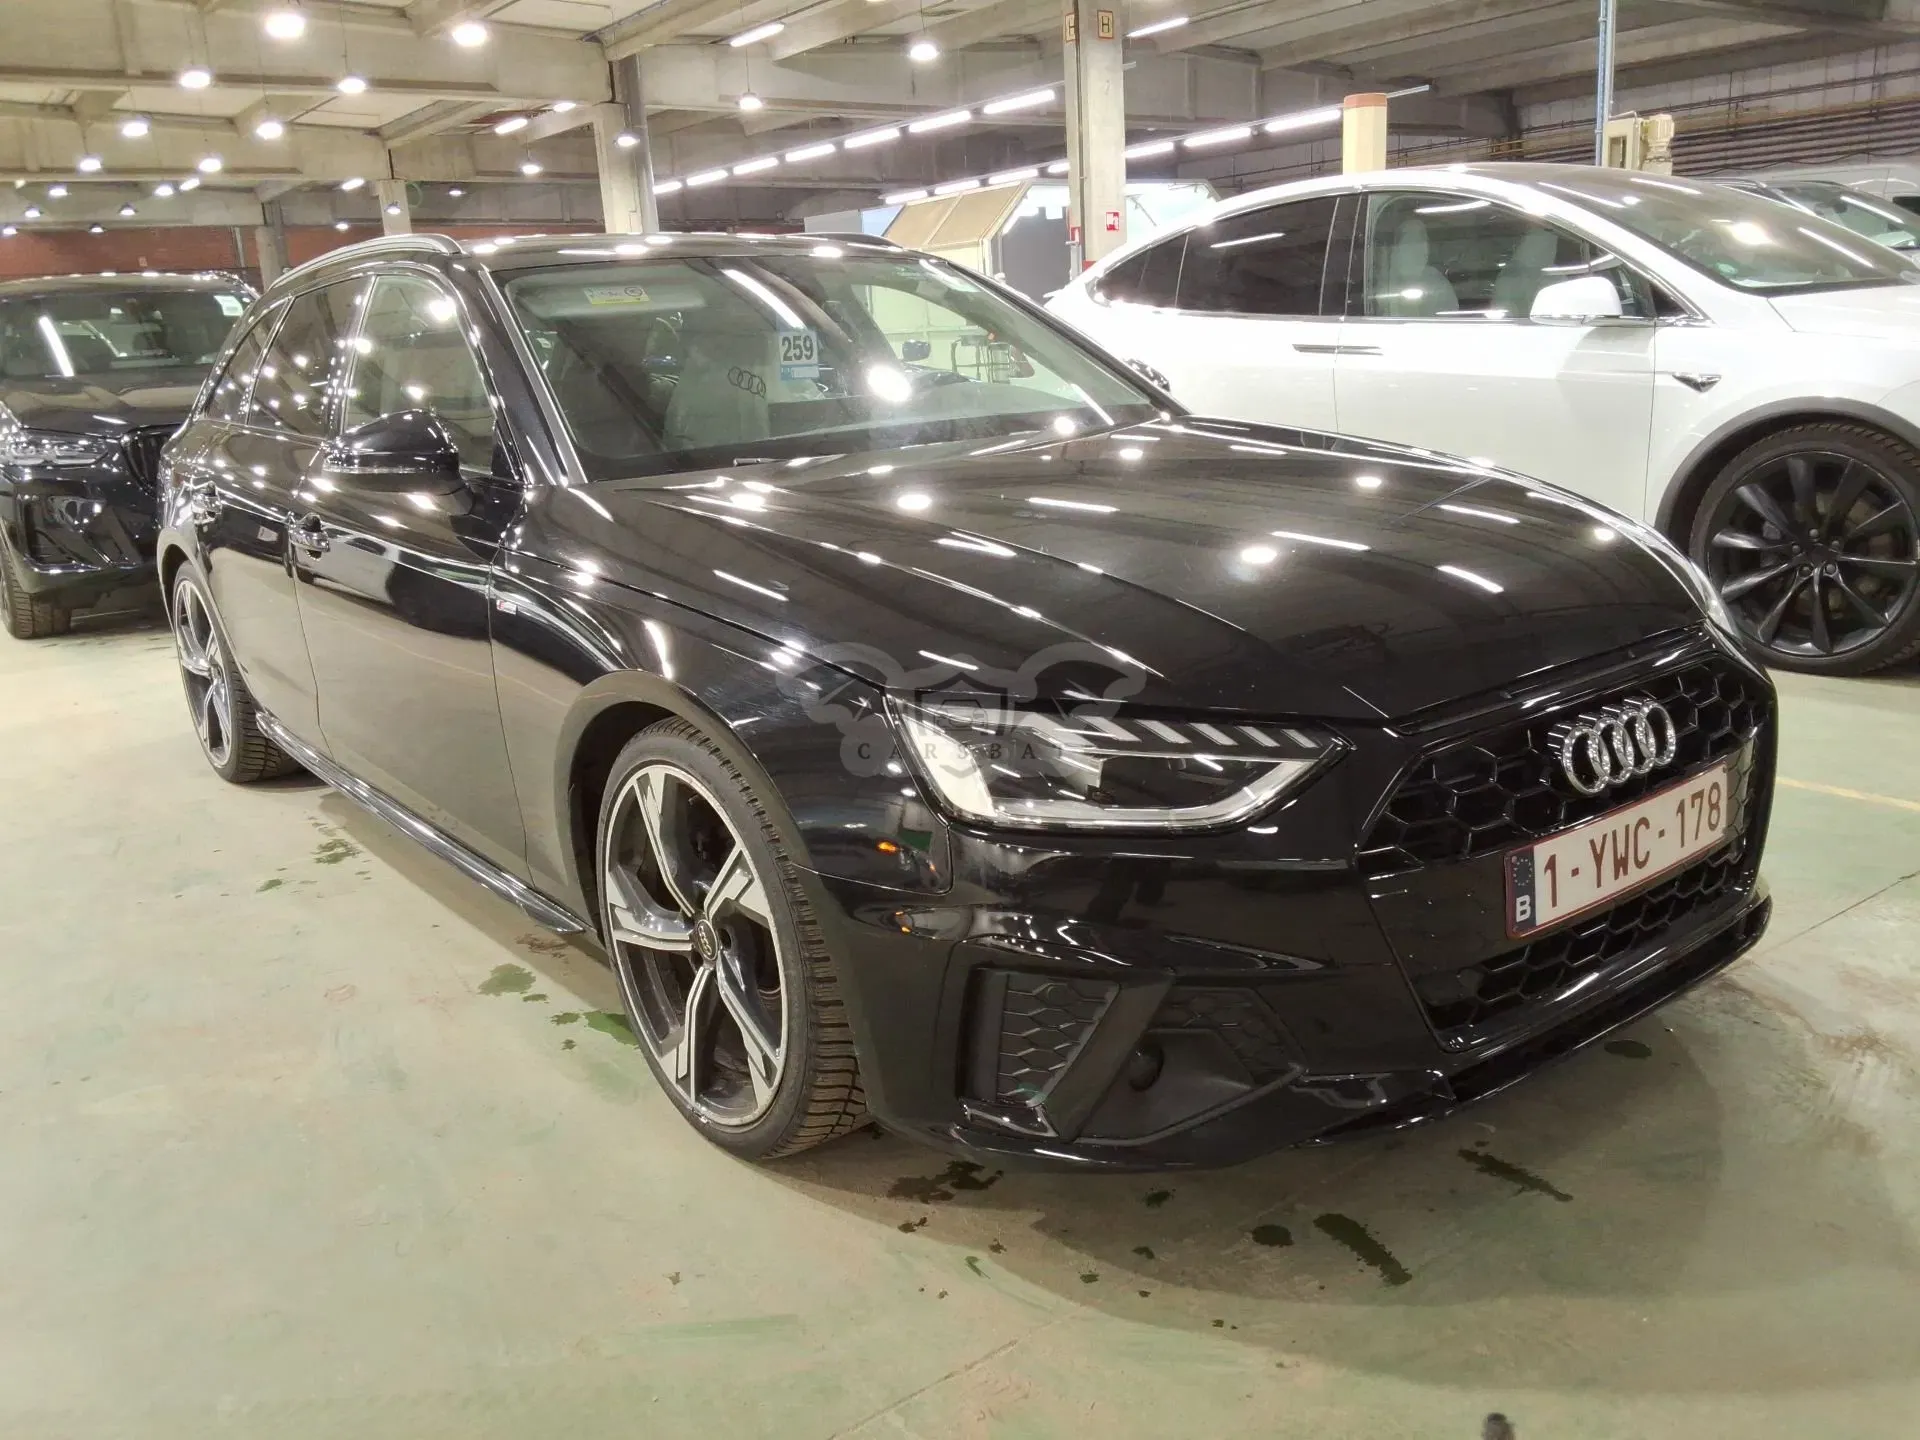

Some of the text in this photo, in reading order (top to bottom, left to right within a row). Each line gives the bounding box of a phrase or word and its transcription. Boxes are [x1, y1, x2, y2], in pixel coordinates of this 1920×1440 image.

[1101, 15, 1110, 33] H
[781, 335, 813, 362] 259
[1543, 781, 1721, 908] 1-YWC-178
[1515, 894, 1531, 923] B
